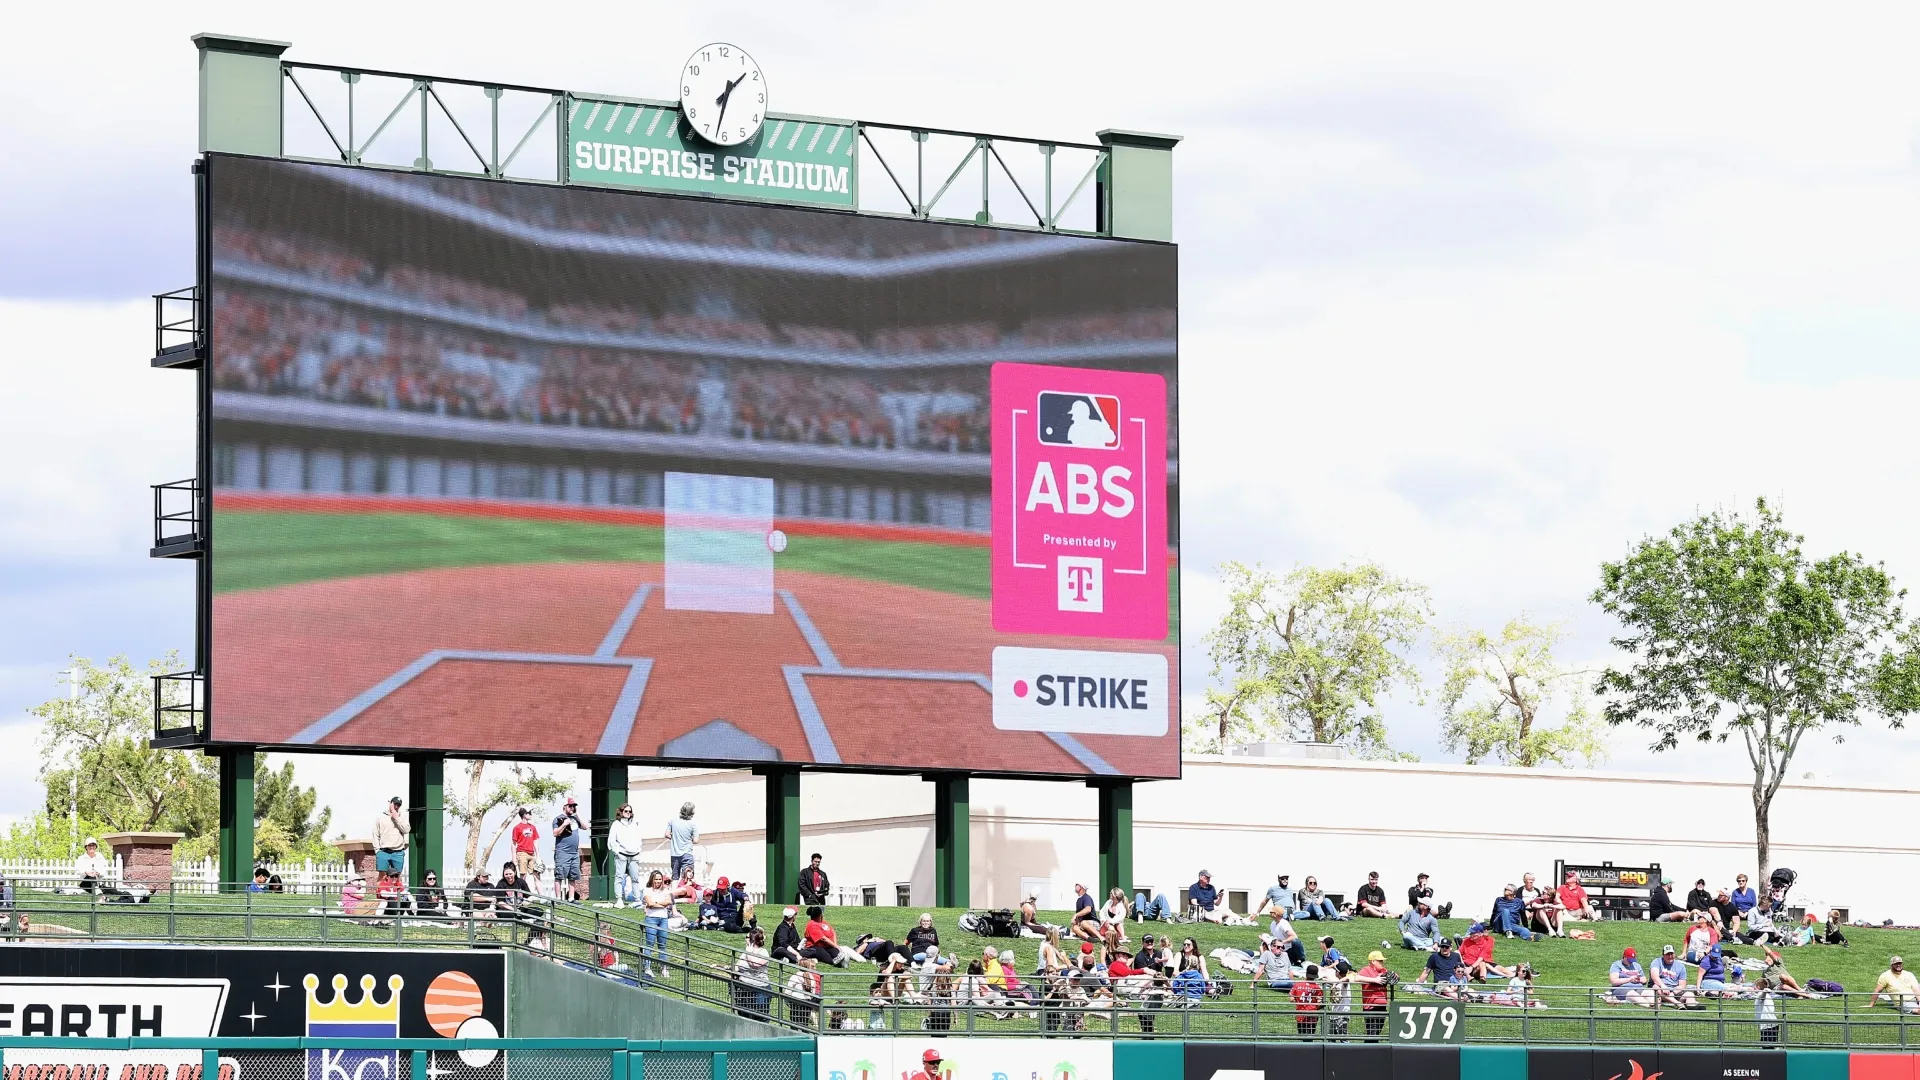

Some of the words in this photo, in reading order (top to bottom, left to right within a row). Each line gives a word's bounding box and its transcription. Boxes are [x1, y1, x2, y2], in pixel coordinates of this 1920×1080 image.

[702, 52, 710, 62] 11
[718, 47, 729, 58] 12
[740, 55, 745, 66] 1
[689, 65, 700, 76] 10
[752, 70, 759, 81] 2
[683, 86, 690, 97] 9
[758, 93, 765, 104] 3
[689, 108, 696, 119] 8
[752, 113, 759, 124] 4
[704, 123, 710, 134] 7
[740, 127, 746, 138] 5
[721, 132, 728, 142] 6
[575, 140, 715, 181] SURPRISE
[723, 156, 849, 194] STADIUM
[1025, 461, 1135, 518] ABS
[1043, 533, 1101, 547] Presented
[1103, 538, 1117, 550] by
[1036, 674, 1148, 710] STRIKE
[1578, 869, 1599, 878] WALK
[1600, 870, 1619, 879] THRU
[1399, 1006, 1458, 1040] 379
[1723, 1069, 1732, 1077] AS
[1733, 1069, 1750, 1077] SEEN
[1750, 1069, 1760, 1077] ON
